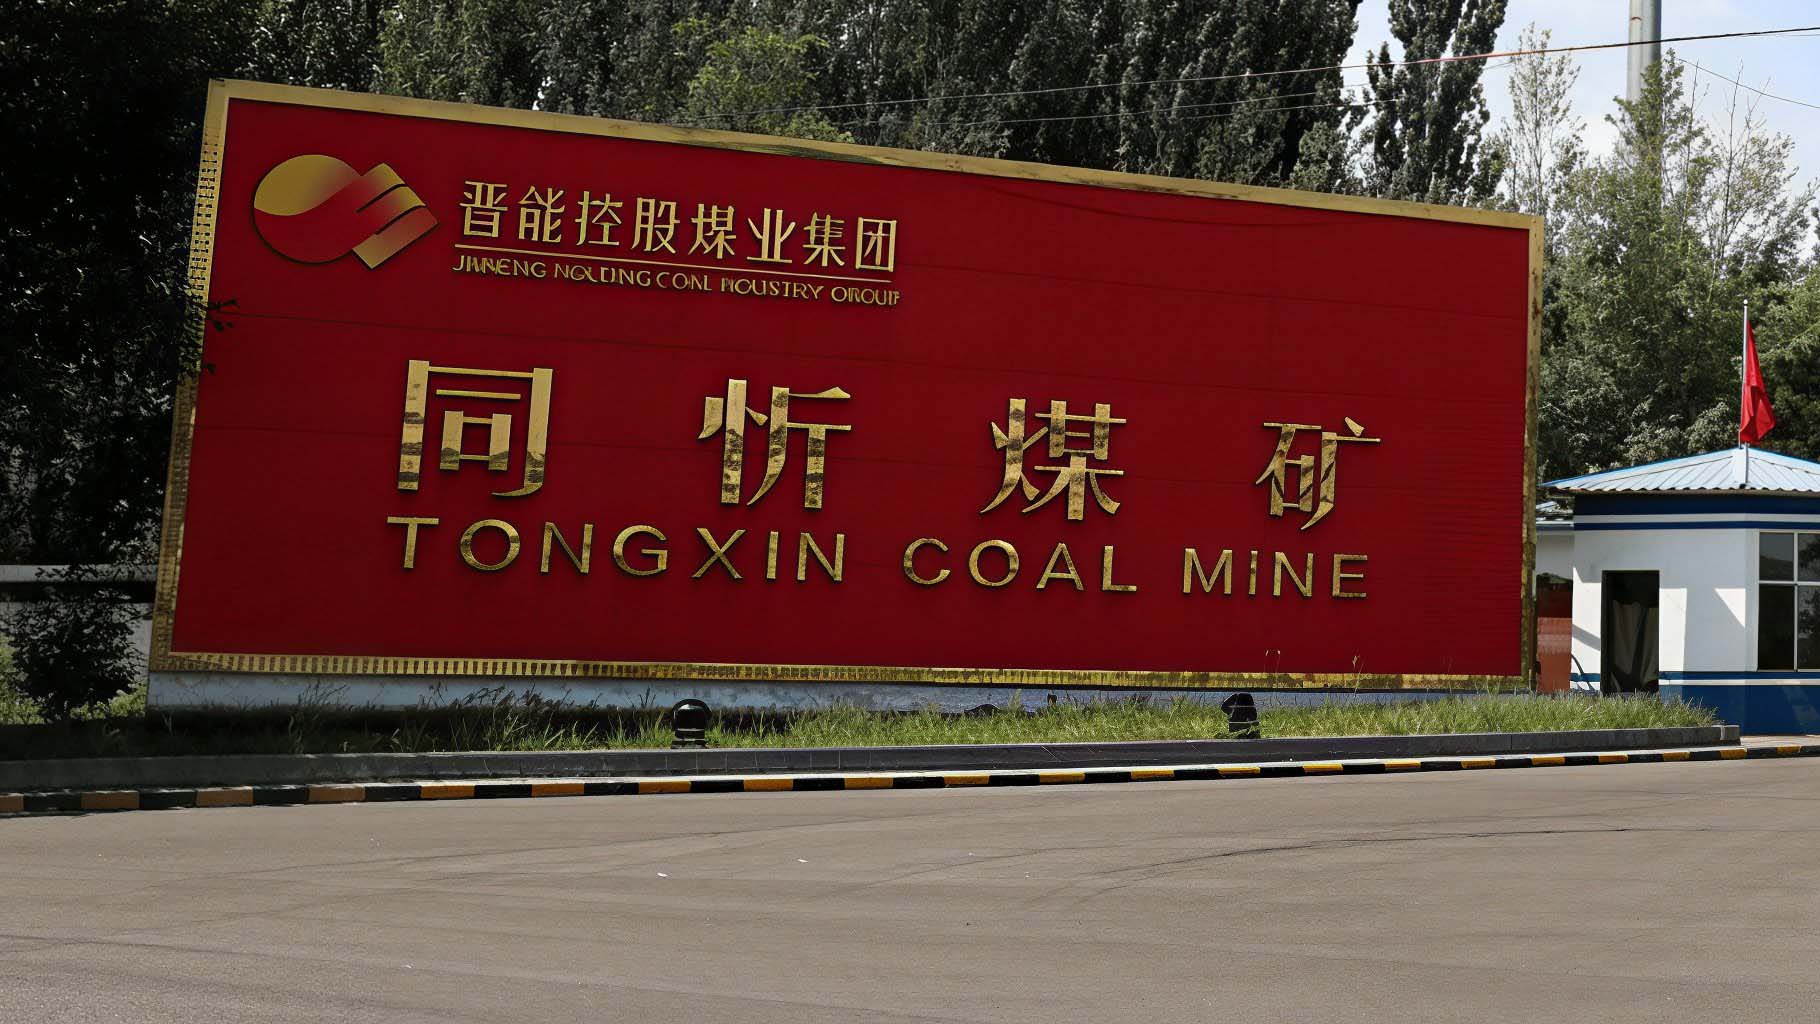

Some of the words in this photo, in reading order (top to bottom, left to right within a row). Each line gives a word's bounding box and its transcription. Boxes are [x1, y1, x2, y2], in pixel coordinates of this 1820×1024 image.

[459, 179, 898, 273] 晋能控股煤业集团
[396, 359, 1382, 532] 同忻煤矿
[386, 515, 846, 583] TONGXIN
[902, 537, 1138, 593] COAL
[1181, 547, 1369, 600] MINE
